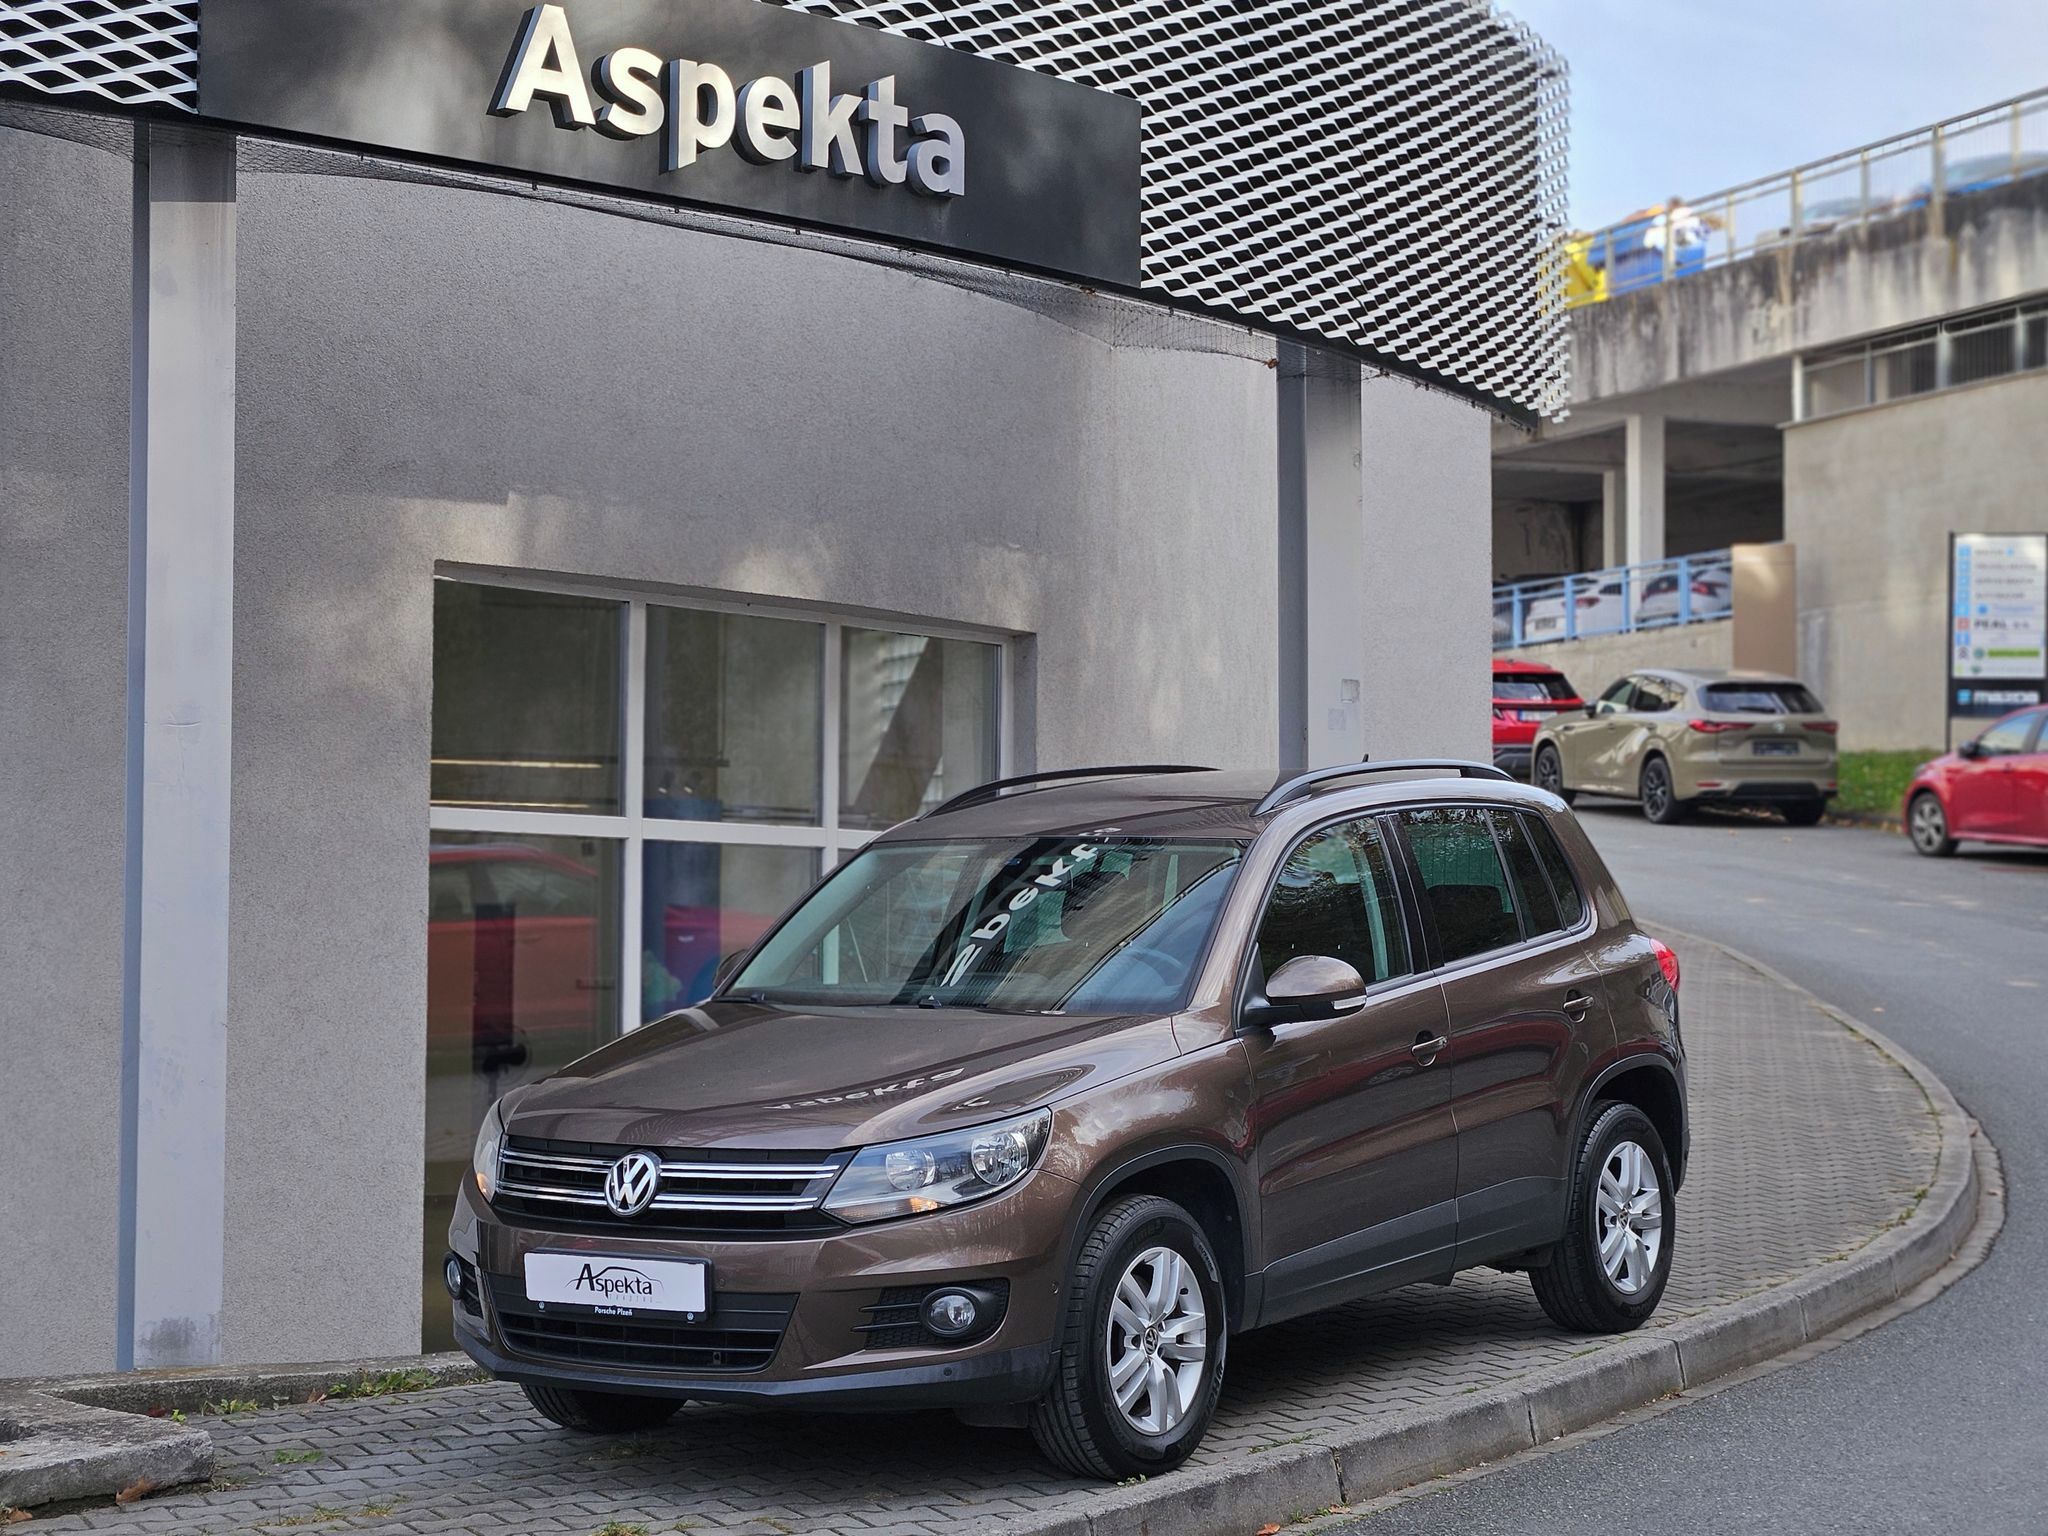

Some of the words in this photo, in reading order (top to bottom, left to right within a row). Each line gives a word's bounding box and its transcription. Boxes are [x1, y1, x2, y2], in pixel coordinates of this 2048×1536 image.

[490, 3, 966, 197] Aspekta
[575, 1263, 653, 1299] Aspekta
[594, 1306, 616, 1315] Porsche
[617, 1307, 633, 1316] Plzeň
